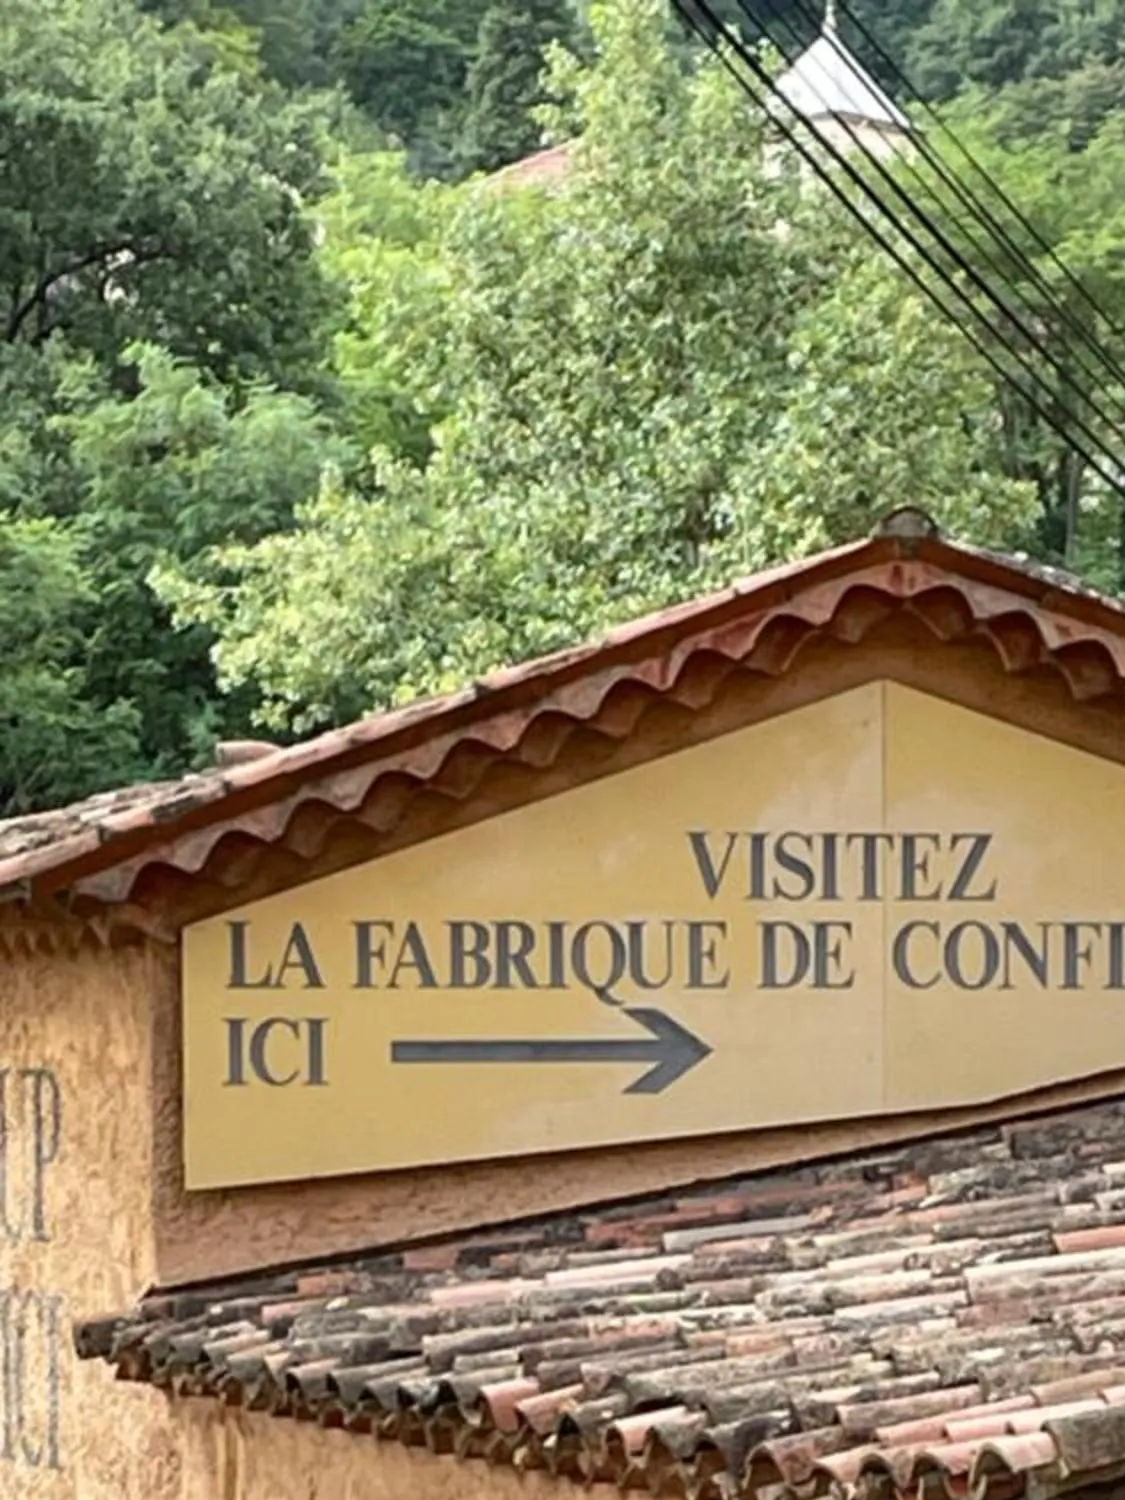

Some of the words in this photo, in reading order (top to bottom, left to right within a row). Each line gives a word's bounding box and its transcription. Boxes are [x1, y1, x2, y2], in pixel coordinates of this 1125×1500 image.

[687, 832, 998, 902] VISITEZ
[224, 921, 325, 990] LA
[352, 921, 731, 1006] FABRIQUE
[760, 921, 855, 991] DE
[222, 1017, 331, 1088] ICI
